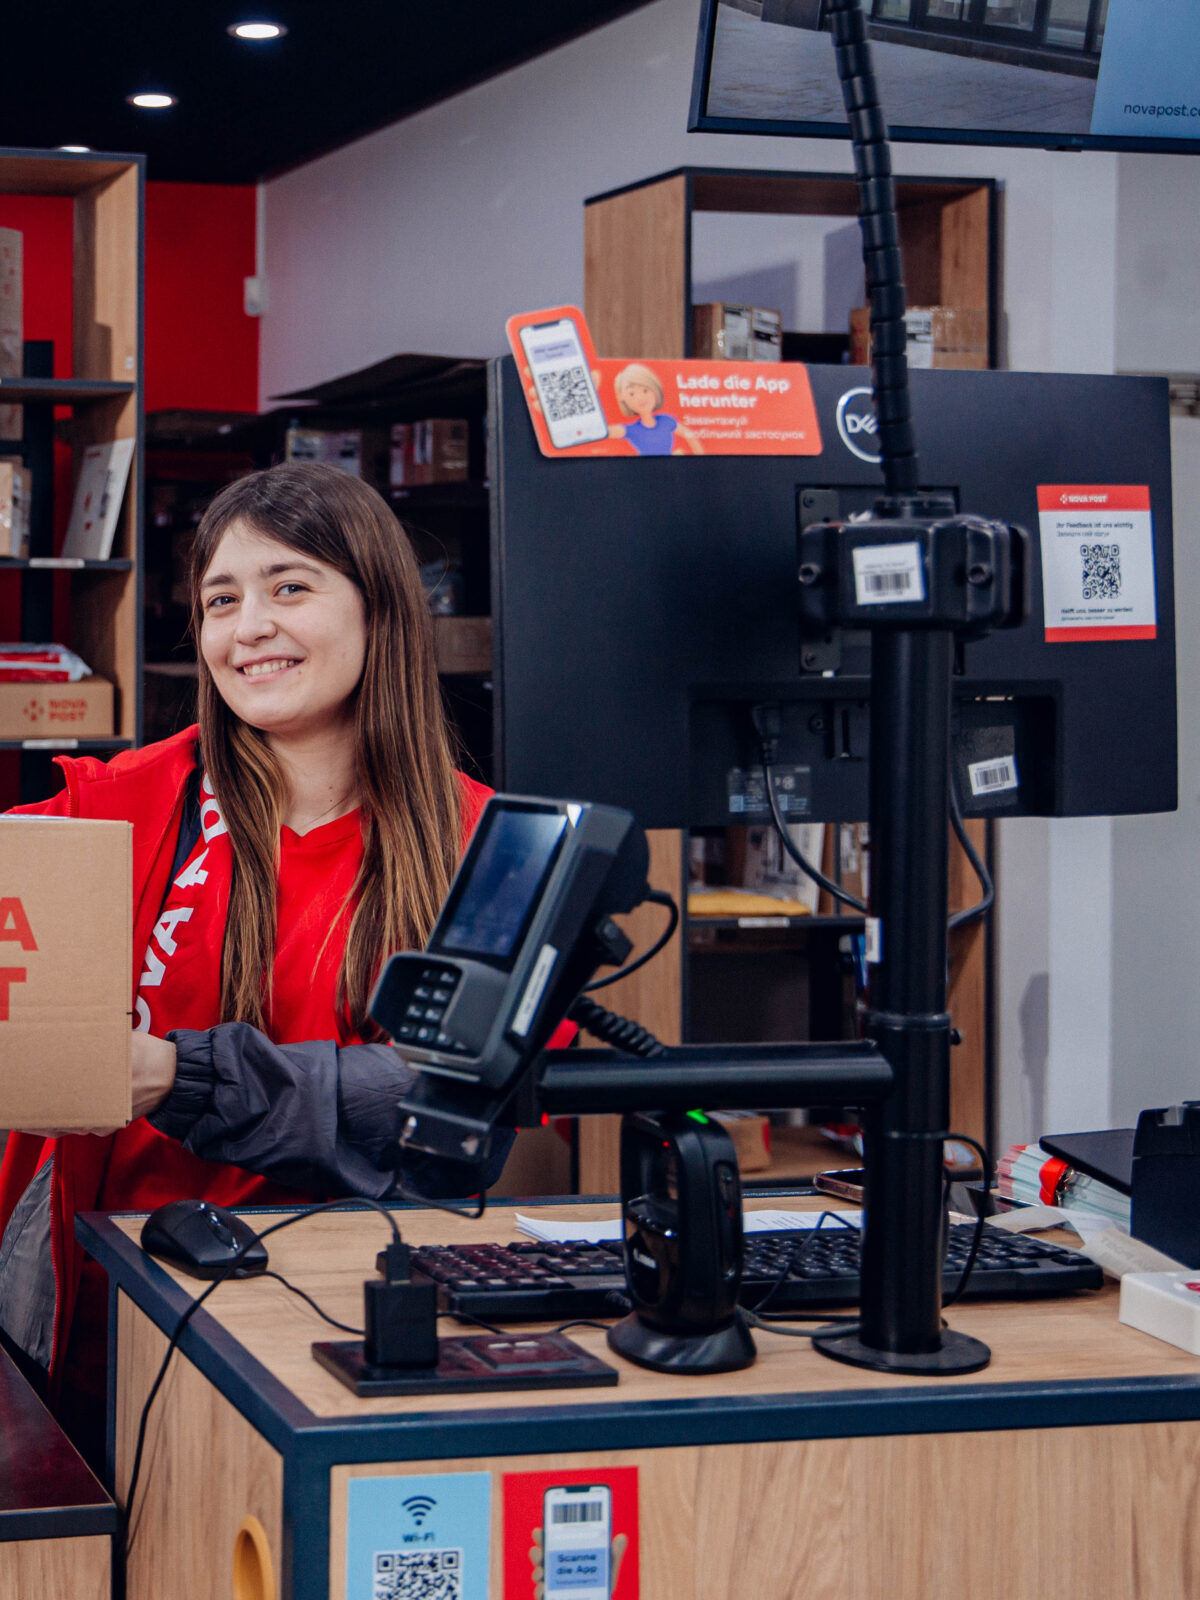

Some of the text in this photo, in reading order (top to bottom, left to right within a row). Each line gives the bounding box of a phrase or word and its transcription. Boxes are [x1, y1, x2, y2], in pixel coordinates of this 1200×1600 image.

[676, 374, 790, 394] Lade die App
[679, 392, 757, 409] herunter
[845, 413, 878, 434] DE
[48, 700, 88, 709] NOVA
[48, 711, 86, 722] POST
[133, 906, 194, 1034] OVA
[402, 1531, 435, 1543] Wi-Fi
[557, 1553, 597, 1563] Scanne
[556, 1564, 597, 1576] die App
